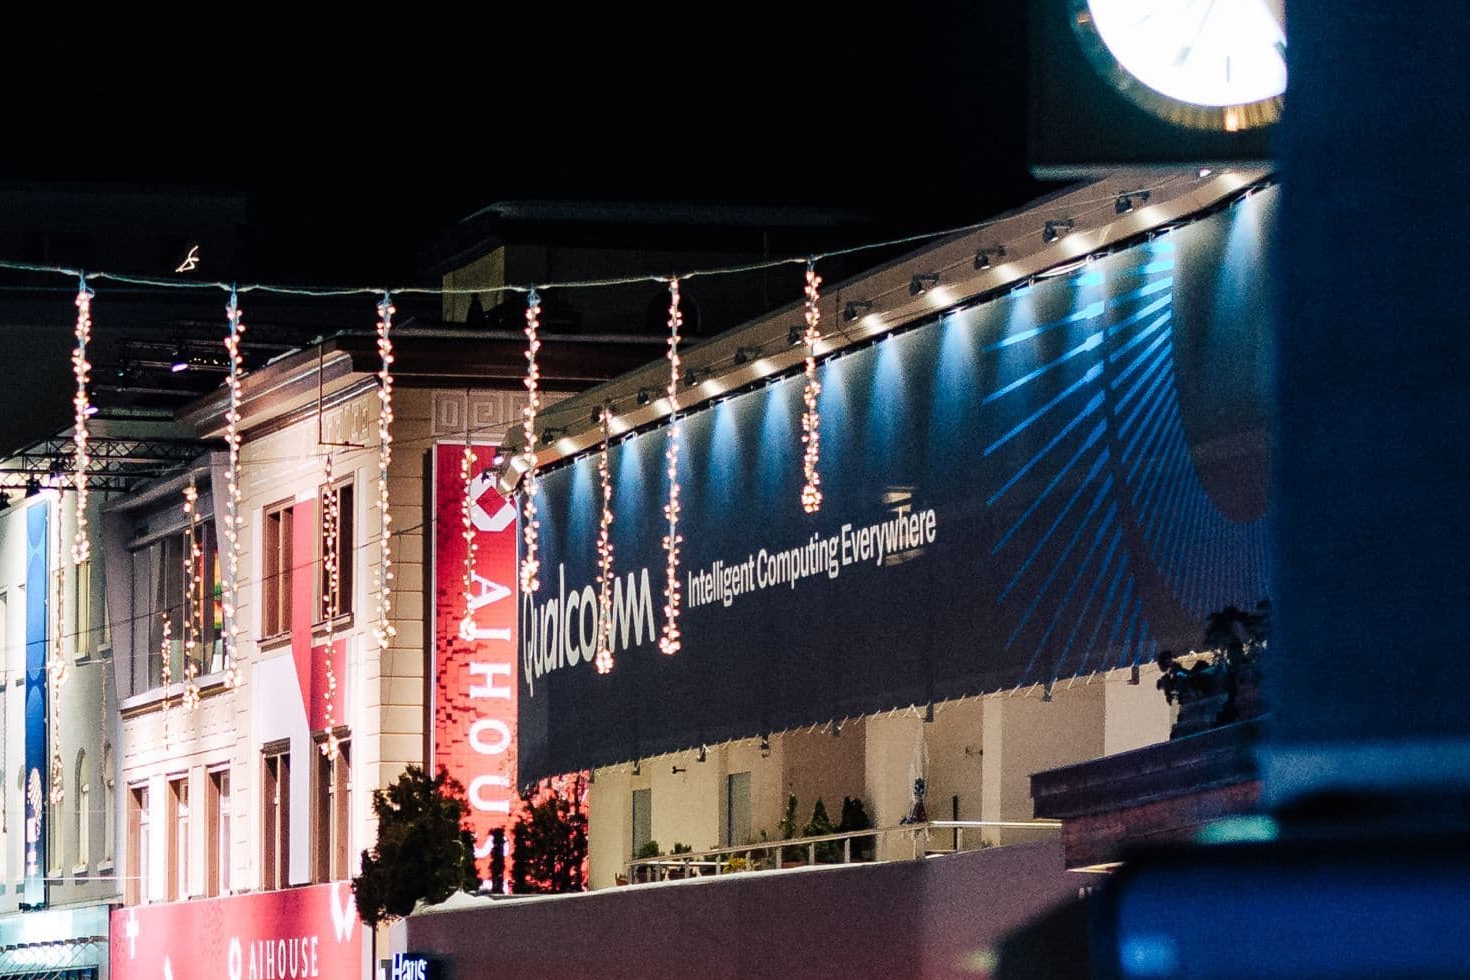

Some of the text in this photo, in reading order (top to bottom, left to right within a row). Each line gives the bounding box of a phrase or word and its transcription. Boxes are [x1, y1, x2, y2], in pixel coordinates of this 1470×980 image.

[688, 508, 937, 609] Intelligent Computing Everywhere
